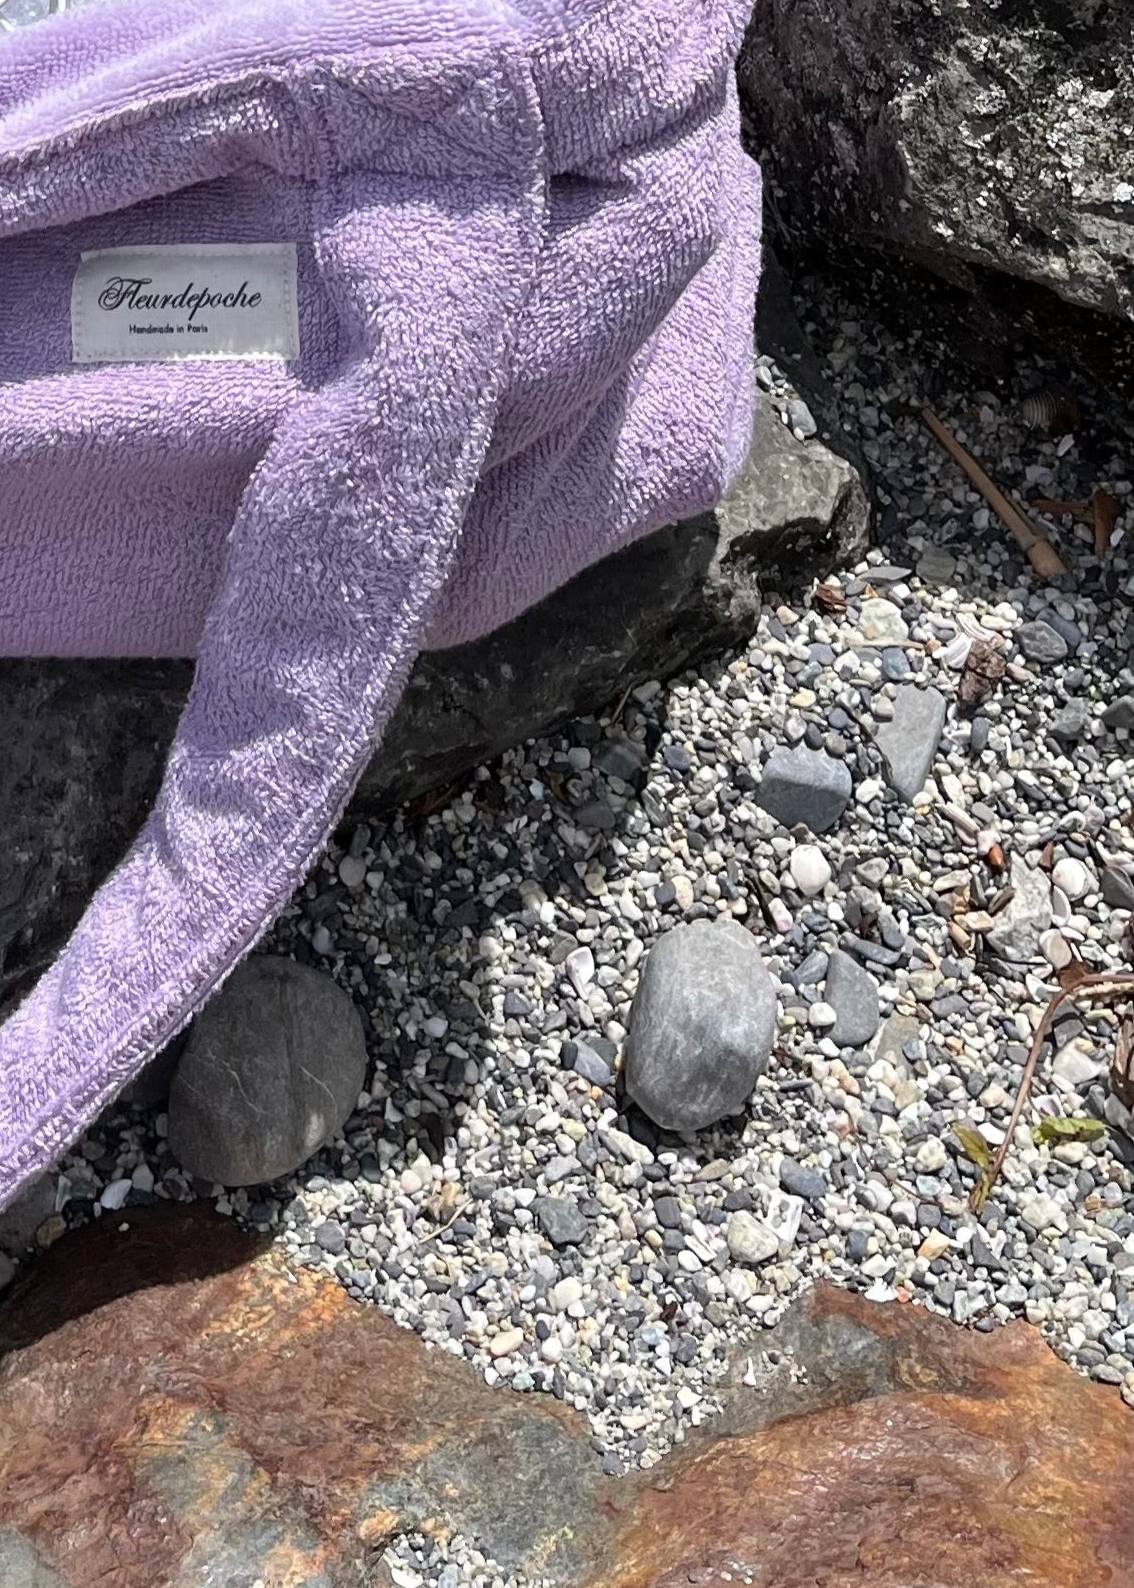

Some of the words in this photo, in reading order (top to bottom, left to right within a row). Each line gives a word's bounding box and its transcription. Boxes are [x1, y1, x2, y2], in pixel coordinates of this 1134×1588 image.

[98, 276, 262, 321] Fleurdepoche
[129, 323, 174, 334] Handmade
[176, 323, 185, 333] in
[187, 323, 208, 333] Paris
